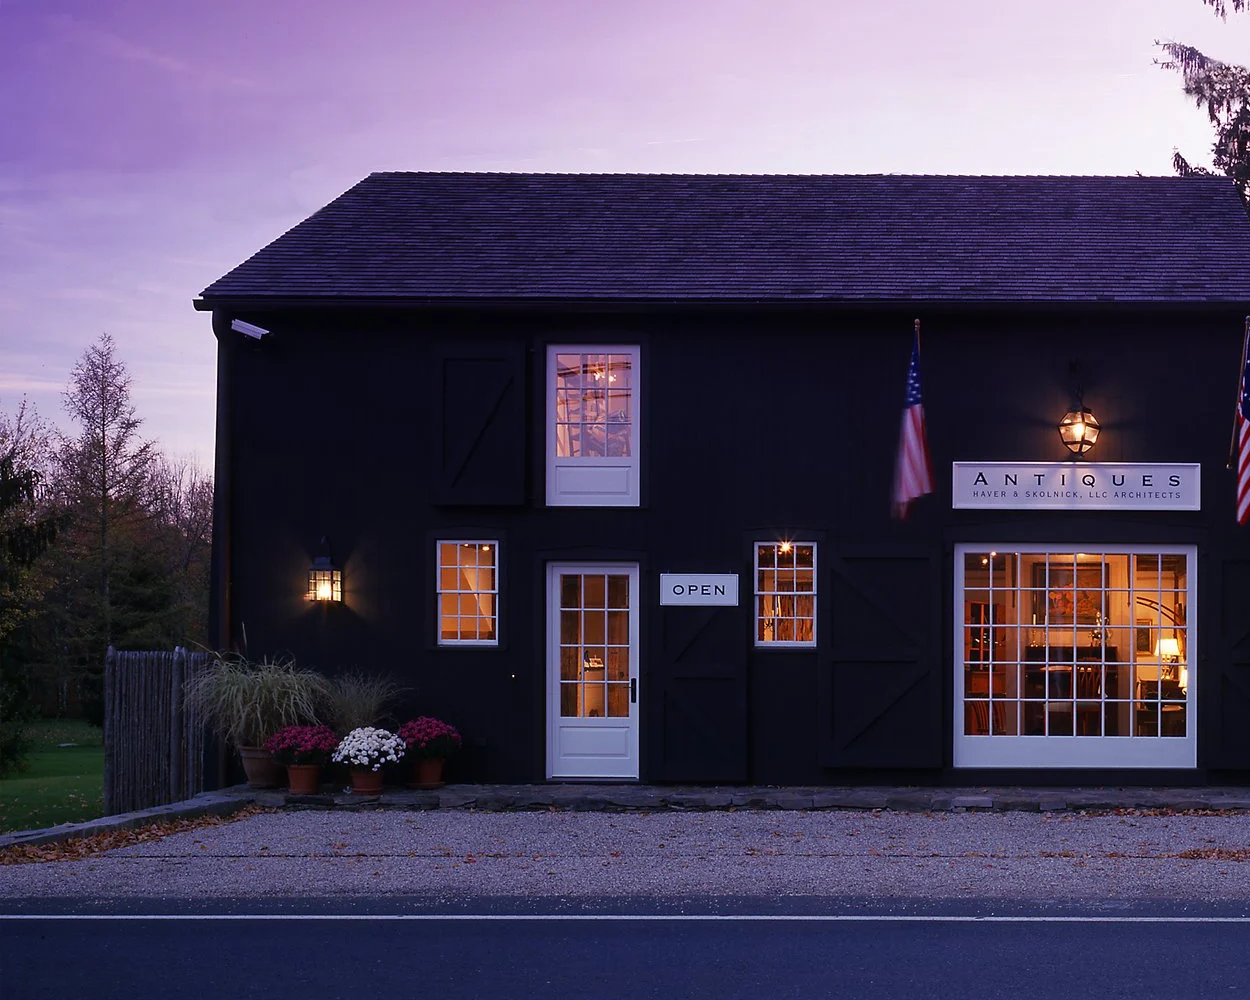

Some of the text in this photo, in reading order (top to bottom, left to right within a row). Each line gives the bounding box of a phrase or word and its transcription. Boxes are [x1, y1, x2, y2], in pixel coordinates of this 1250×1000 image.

[973, 471, 1181, 488] ANTIQUES
[972, 490, 1182, 499] HAVER & SKOLNICK, LLC ARCHITECTS
[672, 584, 725, 596] OPEN
